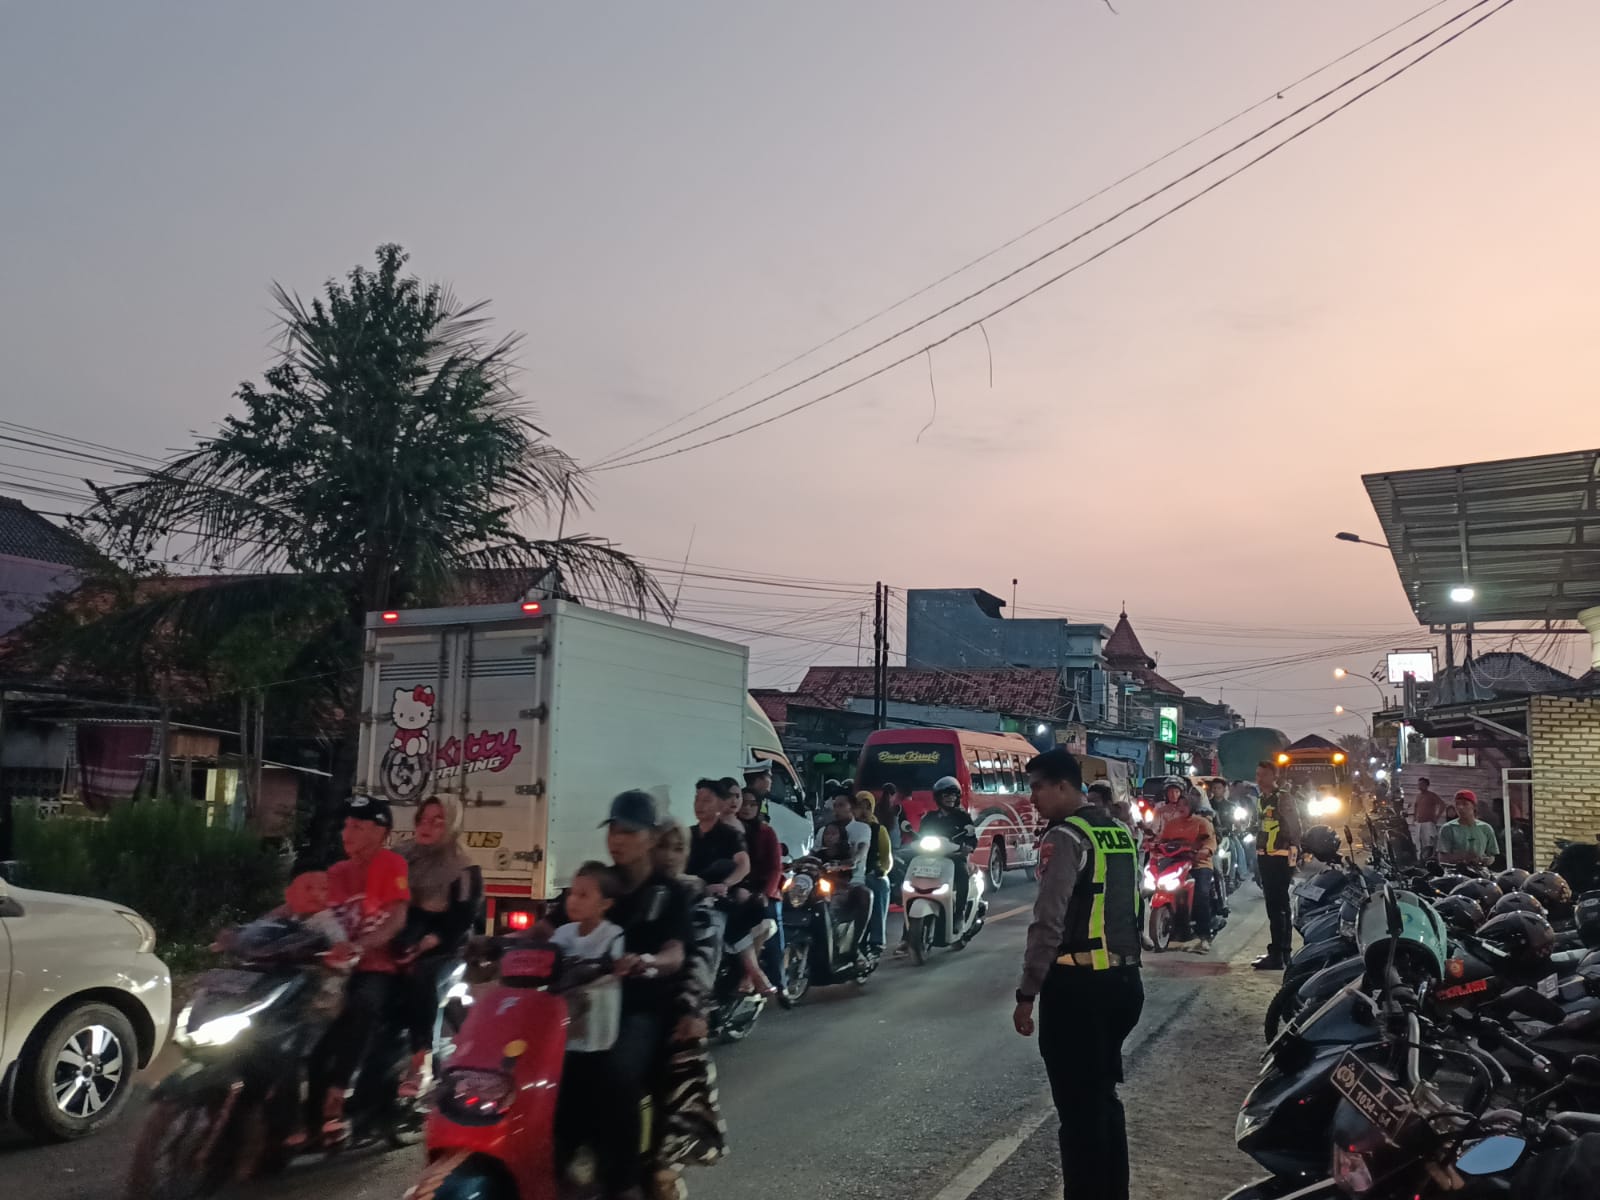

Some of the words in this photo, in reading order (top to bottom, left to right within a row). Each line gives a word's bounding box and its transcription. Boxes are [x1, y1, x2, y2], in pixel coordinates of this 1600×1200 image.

[430, 728, 521, 773] Kitty
[429, 756, 504, 781] RACING
[1376, 1087, 1389, 1100] X
